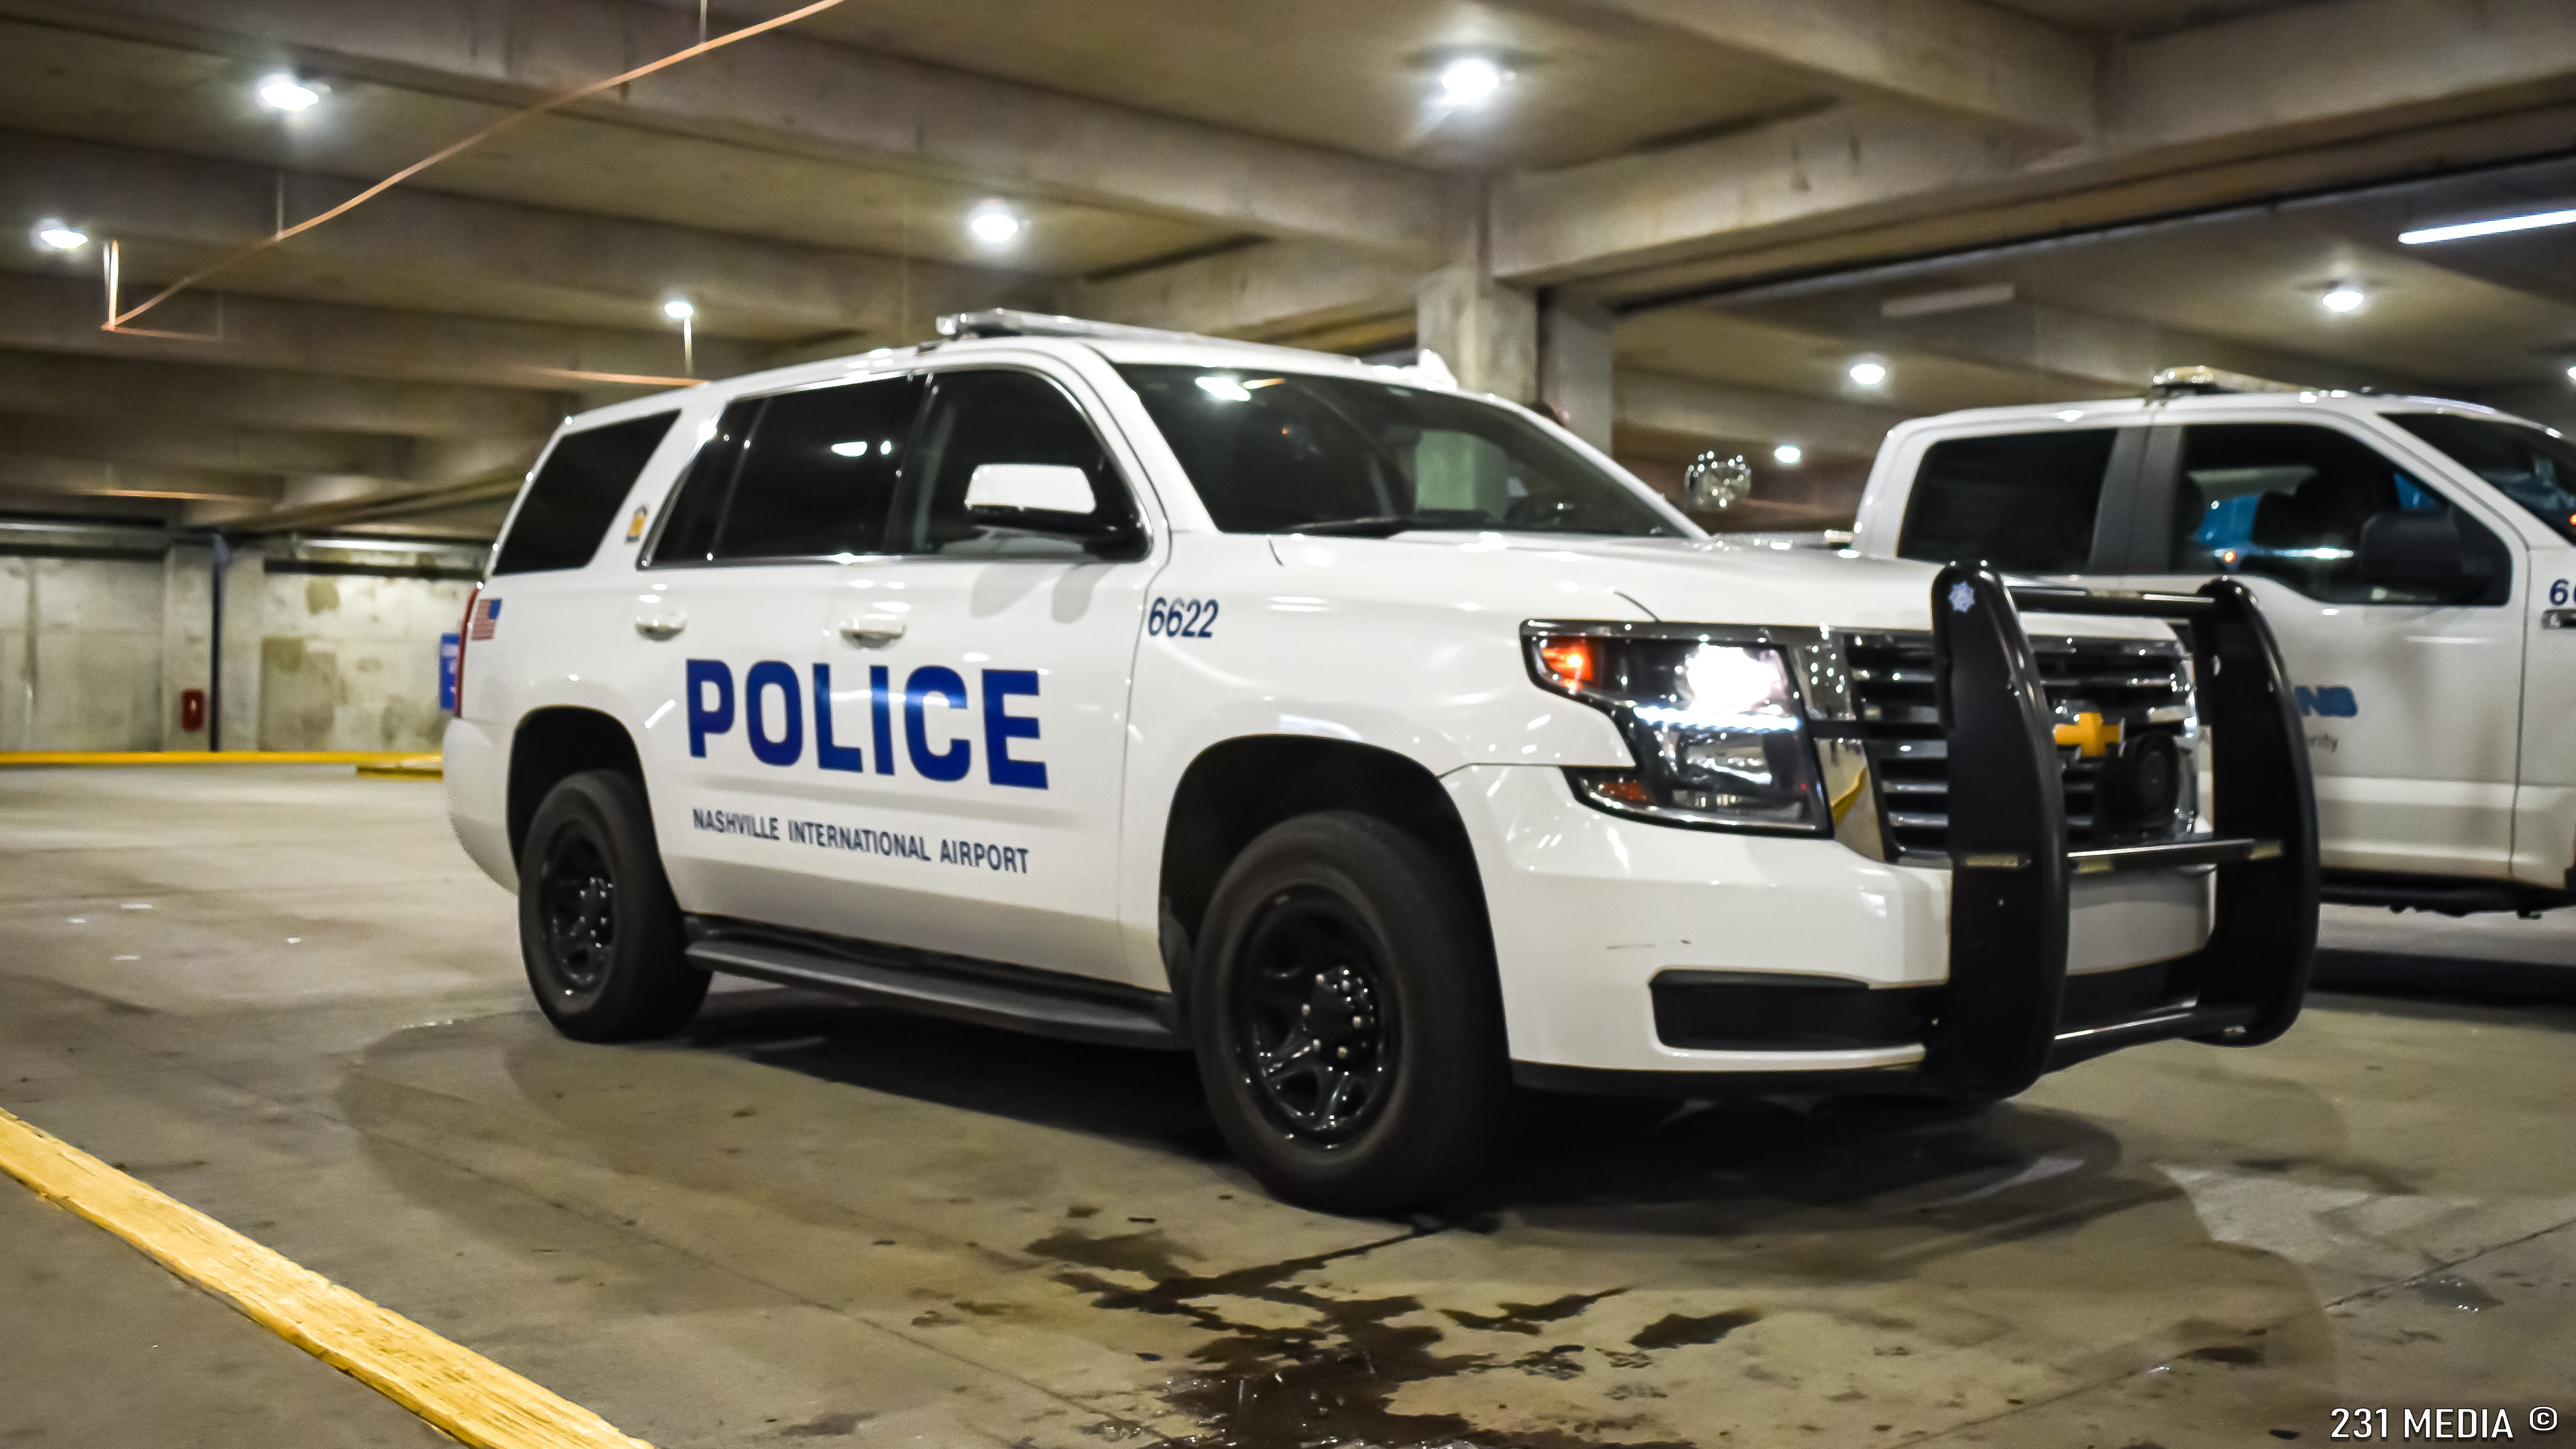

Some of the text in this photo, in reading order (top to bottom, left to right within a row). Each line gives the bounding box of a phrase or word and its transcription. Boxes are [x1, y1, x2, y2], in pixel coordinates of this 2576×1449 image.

[1148, 596, 1219, 638] 6622
[2550, 579, 2576, 606] 6
[686, 659, 1049, 789] POLICE
[692, 808, 1030, 874] NASHVILLE INTERNATIONAL AIRPORT
